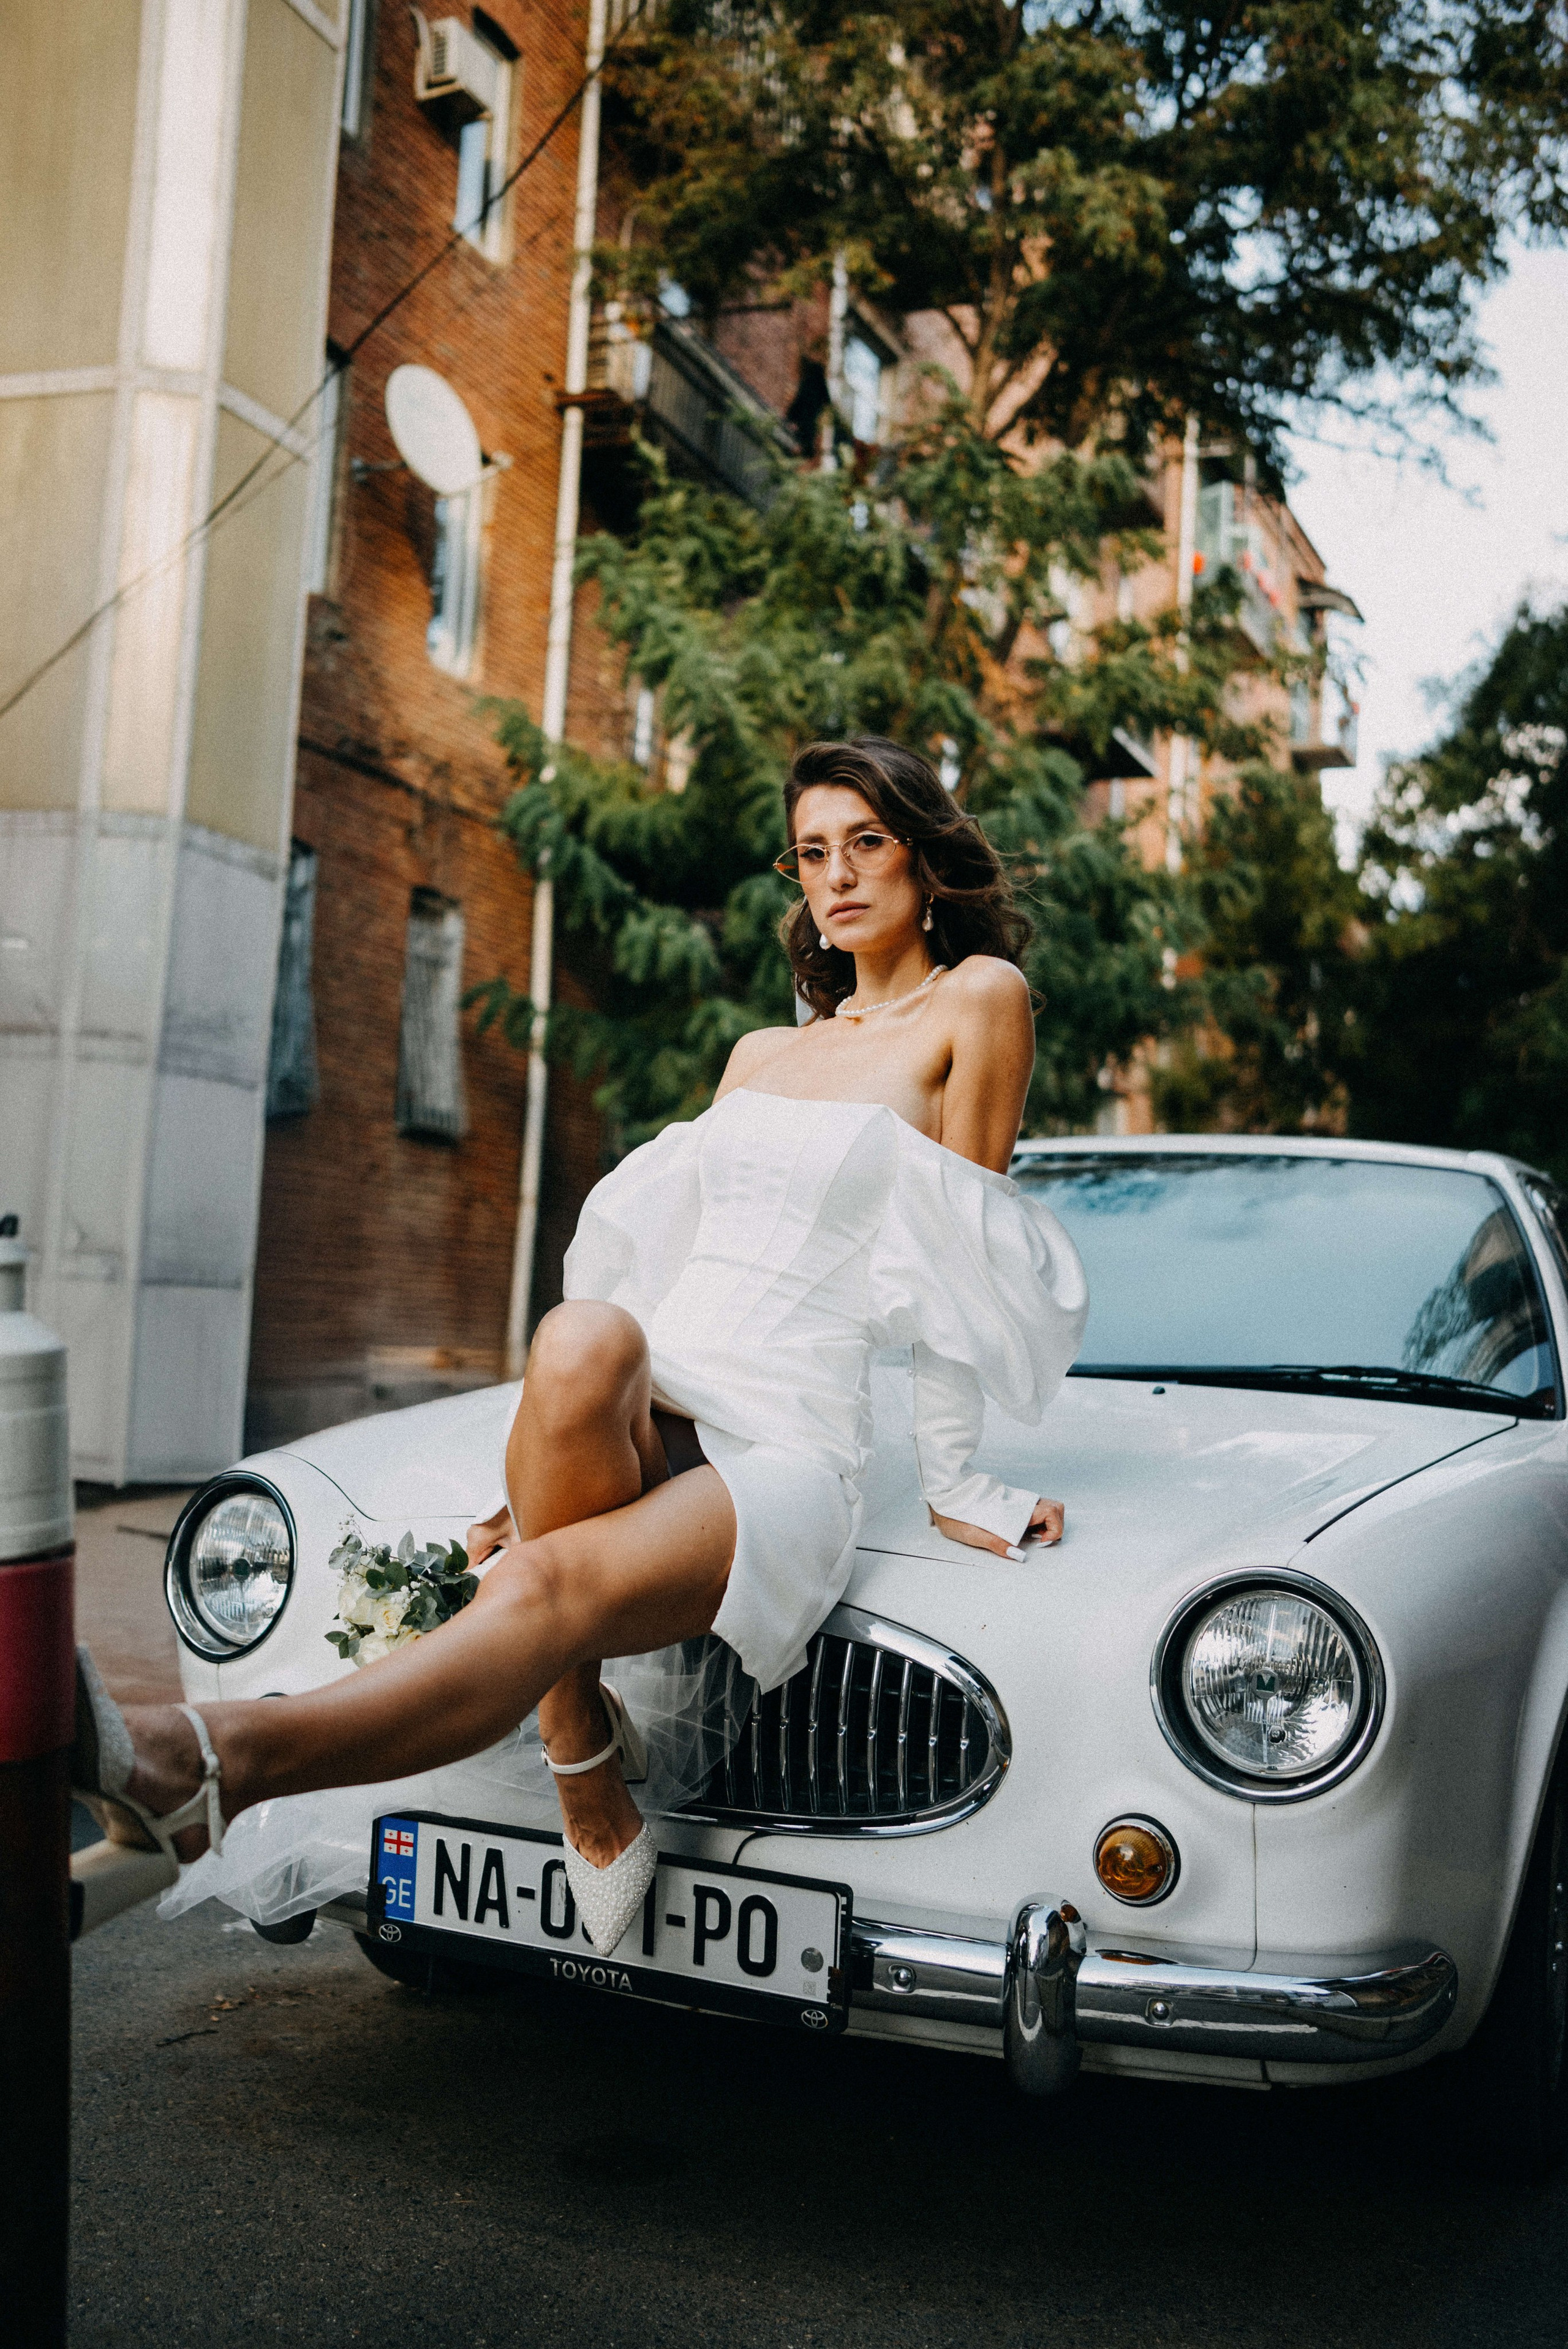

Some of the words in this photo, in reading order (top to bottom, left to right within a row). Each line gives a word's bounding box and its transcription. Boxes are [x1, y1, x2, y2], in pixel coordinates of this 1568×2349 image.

[382, 1876, 412, 1908] GE
[434, 1838, 778, 1977] NA-01-PO
[550, 1958, 633, 1991] TOYOTA
